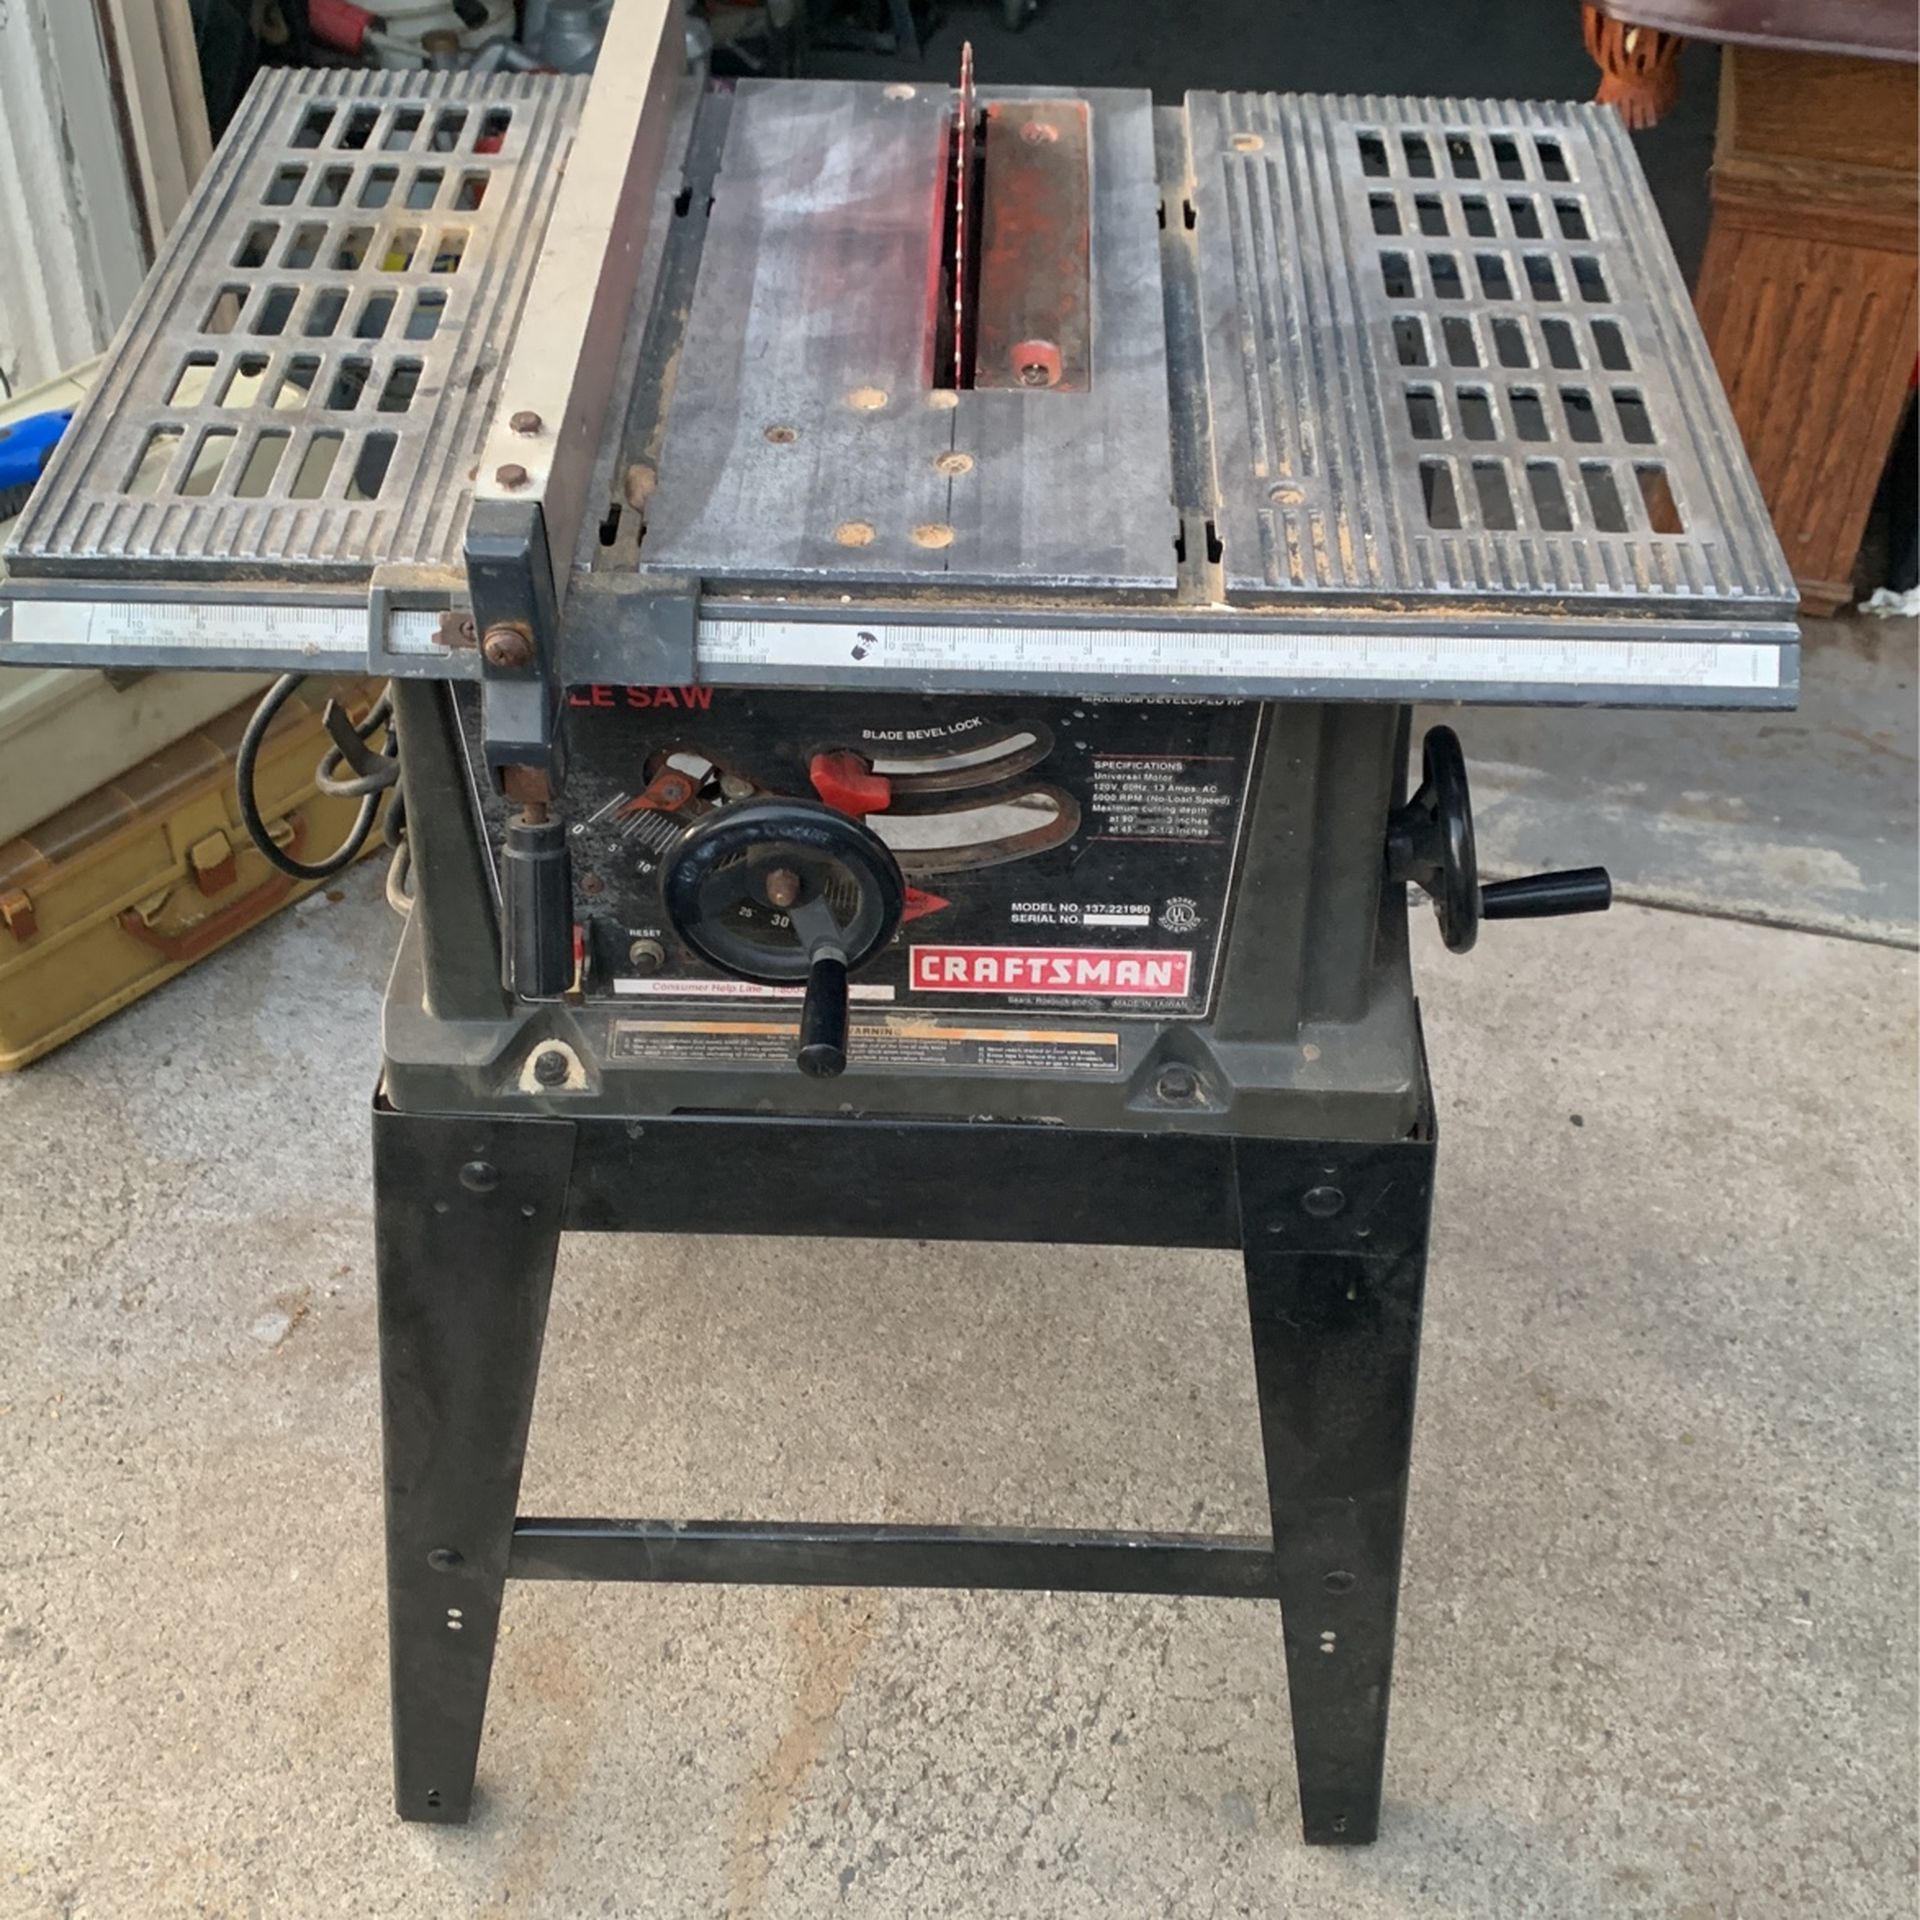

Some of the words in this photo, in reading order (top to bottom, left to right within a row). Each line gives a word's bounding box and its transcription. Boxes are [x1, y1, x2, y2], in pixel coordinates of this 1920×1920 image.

[626, 684, 714, 710] SAW
[862, 729, 904, 741] BLADE
[906, 727, 947, 741] BEVEL
[947, 716, 983, 734] LOCK
[1094, 761, 1183, 772] SPECIFICATIONS
[1094, 772, 1142, 782] Universal
[1143, 773, 1174, 783] Motor
[1202, 785, 1218, 794] AC
[1119, 793, 1143, 803] RPM
[1092, 804, 1139, 813] Maximum
[1178, 805, 1208, 816] depth
[1011, 902, 1056, 913] MODEL
[1059, 903, 1082, 914] NO.
[1011, 913, 1056, 924] SERIAL
[1059, 914, 1082, 925] NO.
[628, 929, 661, 938] RESET
[921, 955, 1172, 986] CRAFTSMAN
[652, 981, 709, 992] Consumer
[711, 983, 737, 994] Help
[739, 983, 763, 994] Line
[1111, 999, 1139, 1008] MADE
